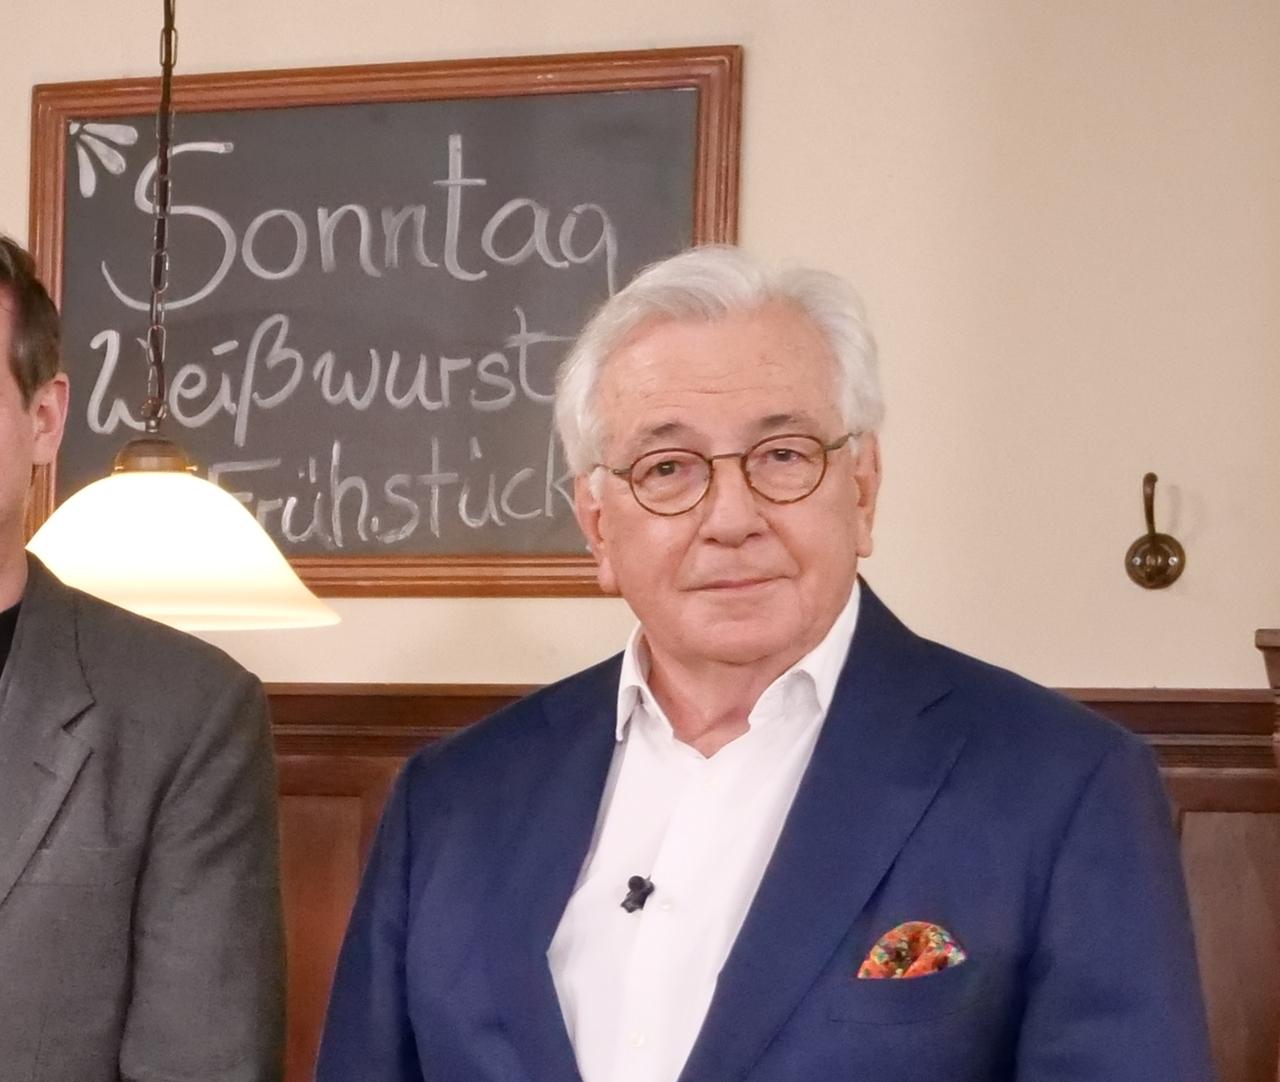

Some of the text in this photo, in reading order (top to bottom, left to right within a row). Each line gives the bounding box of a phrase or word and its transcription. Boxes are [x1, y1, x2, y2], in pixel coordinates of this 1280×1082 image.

[100, 133, 618, 311] Sonntag
[86, 306, 580, 448] Weißwurst
[207, 429, 576, 548] Frühstück
